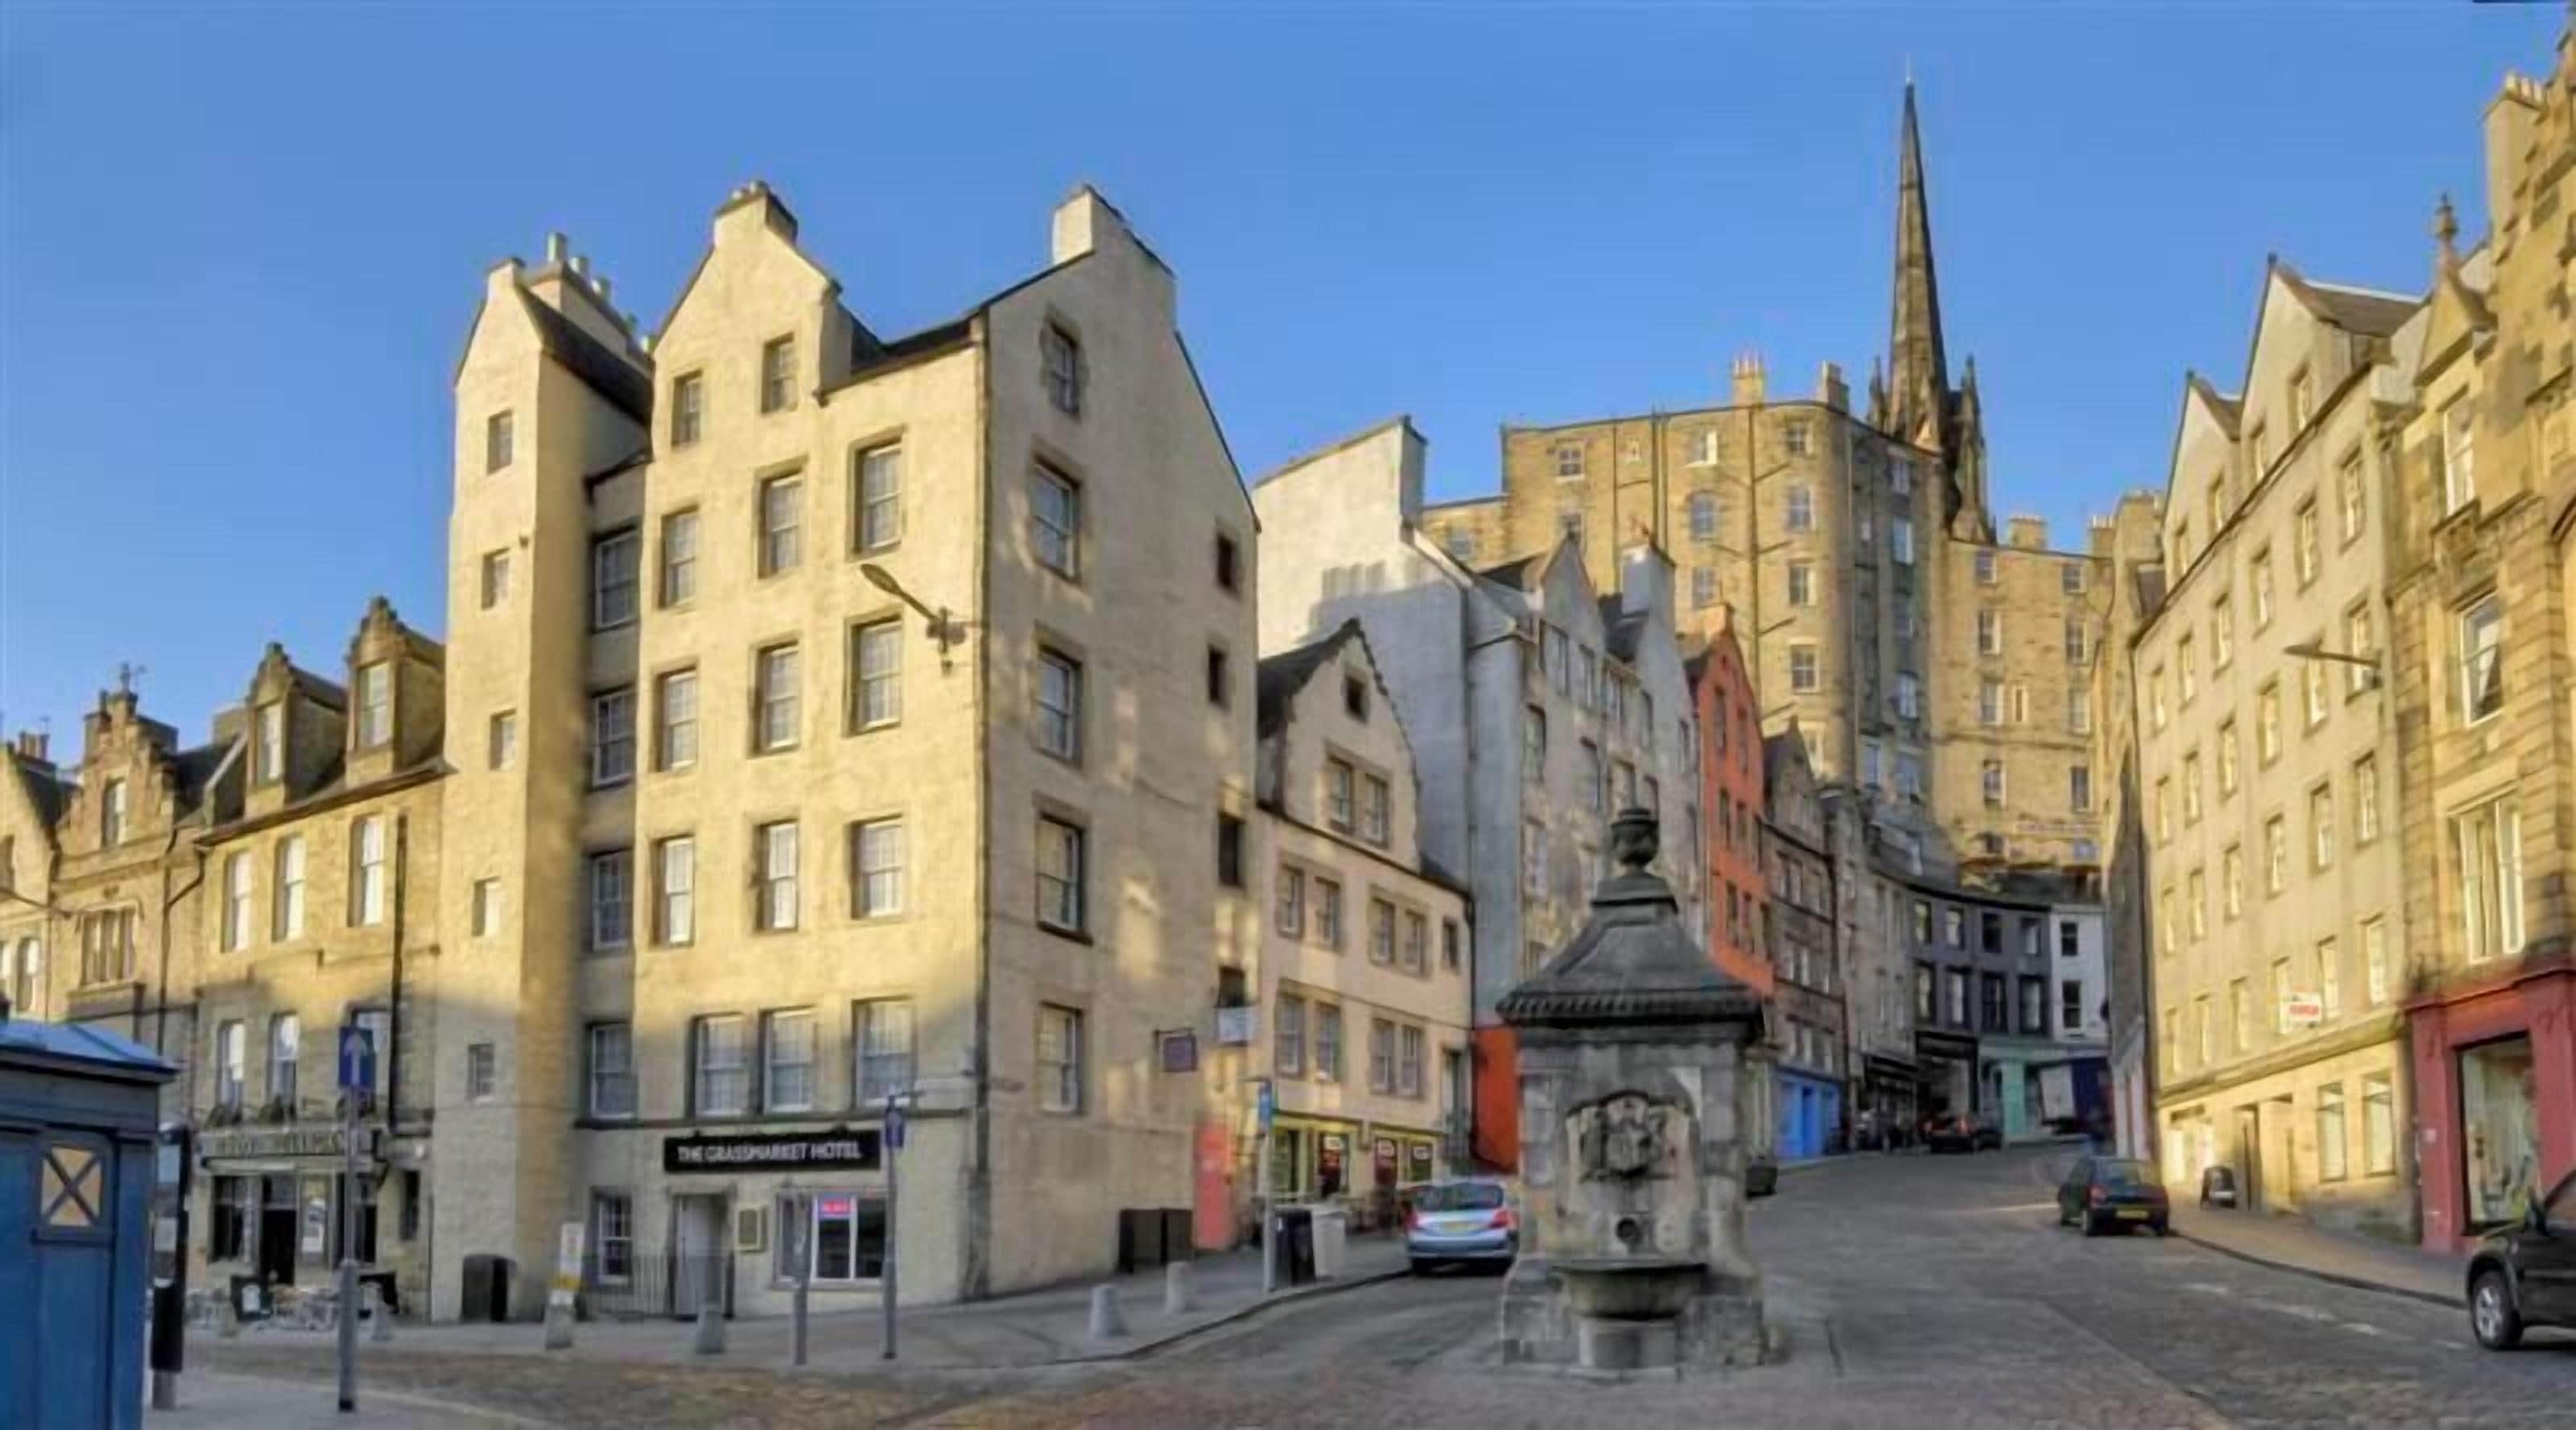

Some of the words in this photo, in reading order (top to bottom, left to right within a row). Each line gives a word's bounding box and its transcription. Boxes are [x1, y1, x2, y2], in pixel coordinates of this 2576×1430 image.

[677, 1145, 703, 1161] THE
[705, 1142, 806, 1161] GRASSMARKET
[811, 1140, 861, 1159] HOTEL
